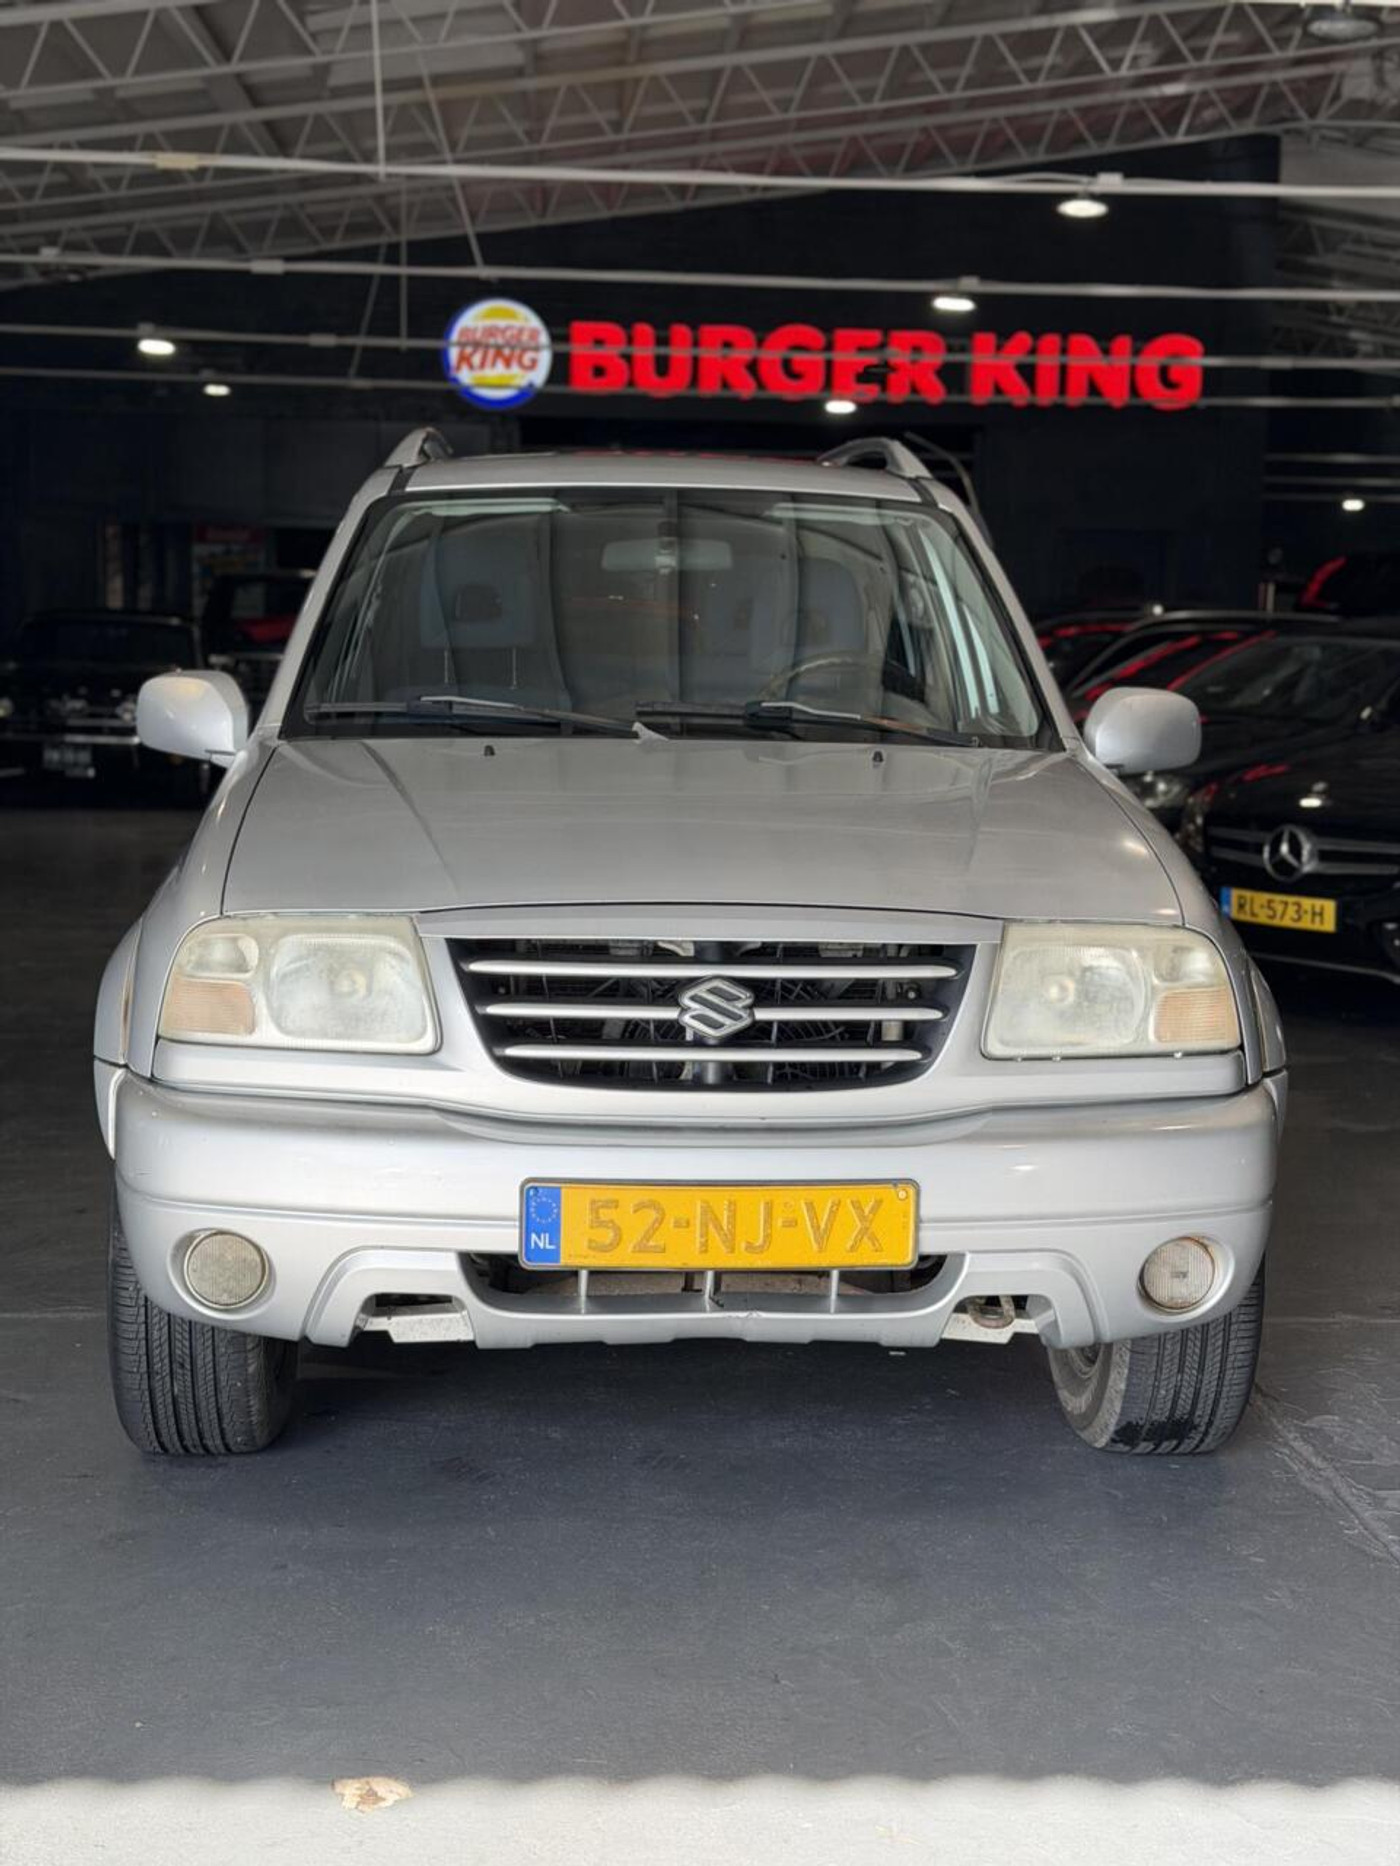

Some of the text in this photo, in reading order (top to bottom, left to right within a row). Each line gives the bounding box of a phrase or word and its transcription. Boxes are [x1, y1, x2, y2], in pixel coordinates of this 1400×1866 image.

[458, 325, 540, 346] BURGER
[455, 345, 539, 374] KING
[569, 320, 1204, 410] BURGER KING
[1236, 894, 1325, 926] RL-573-H
[530, 1231, 556, 1250] NL
[587, 1197, 884, 1254] 52-NJ-VX
